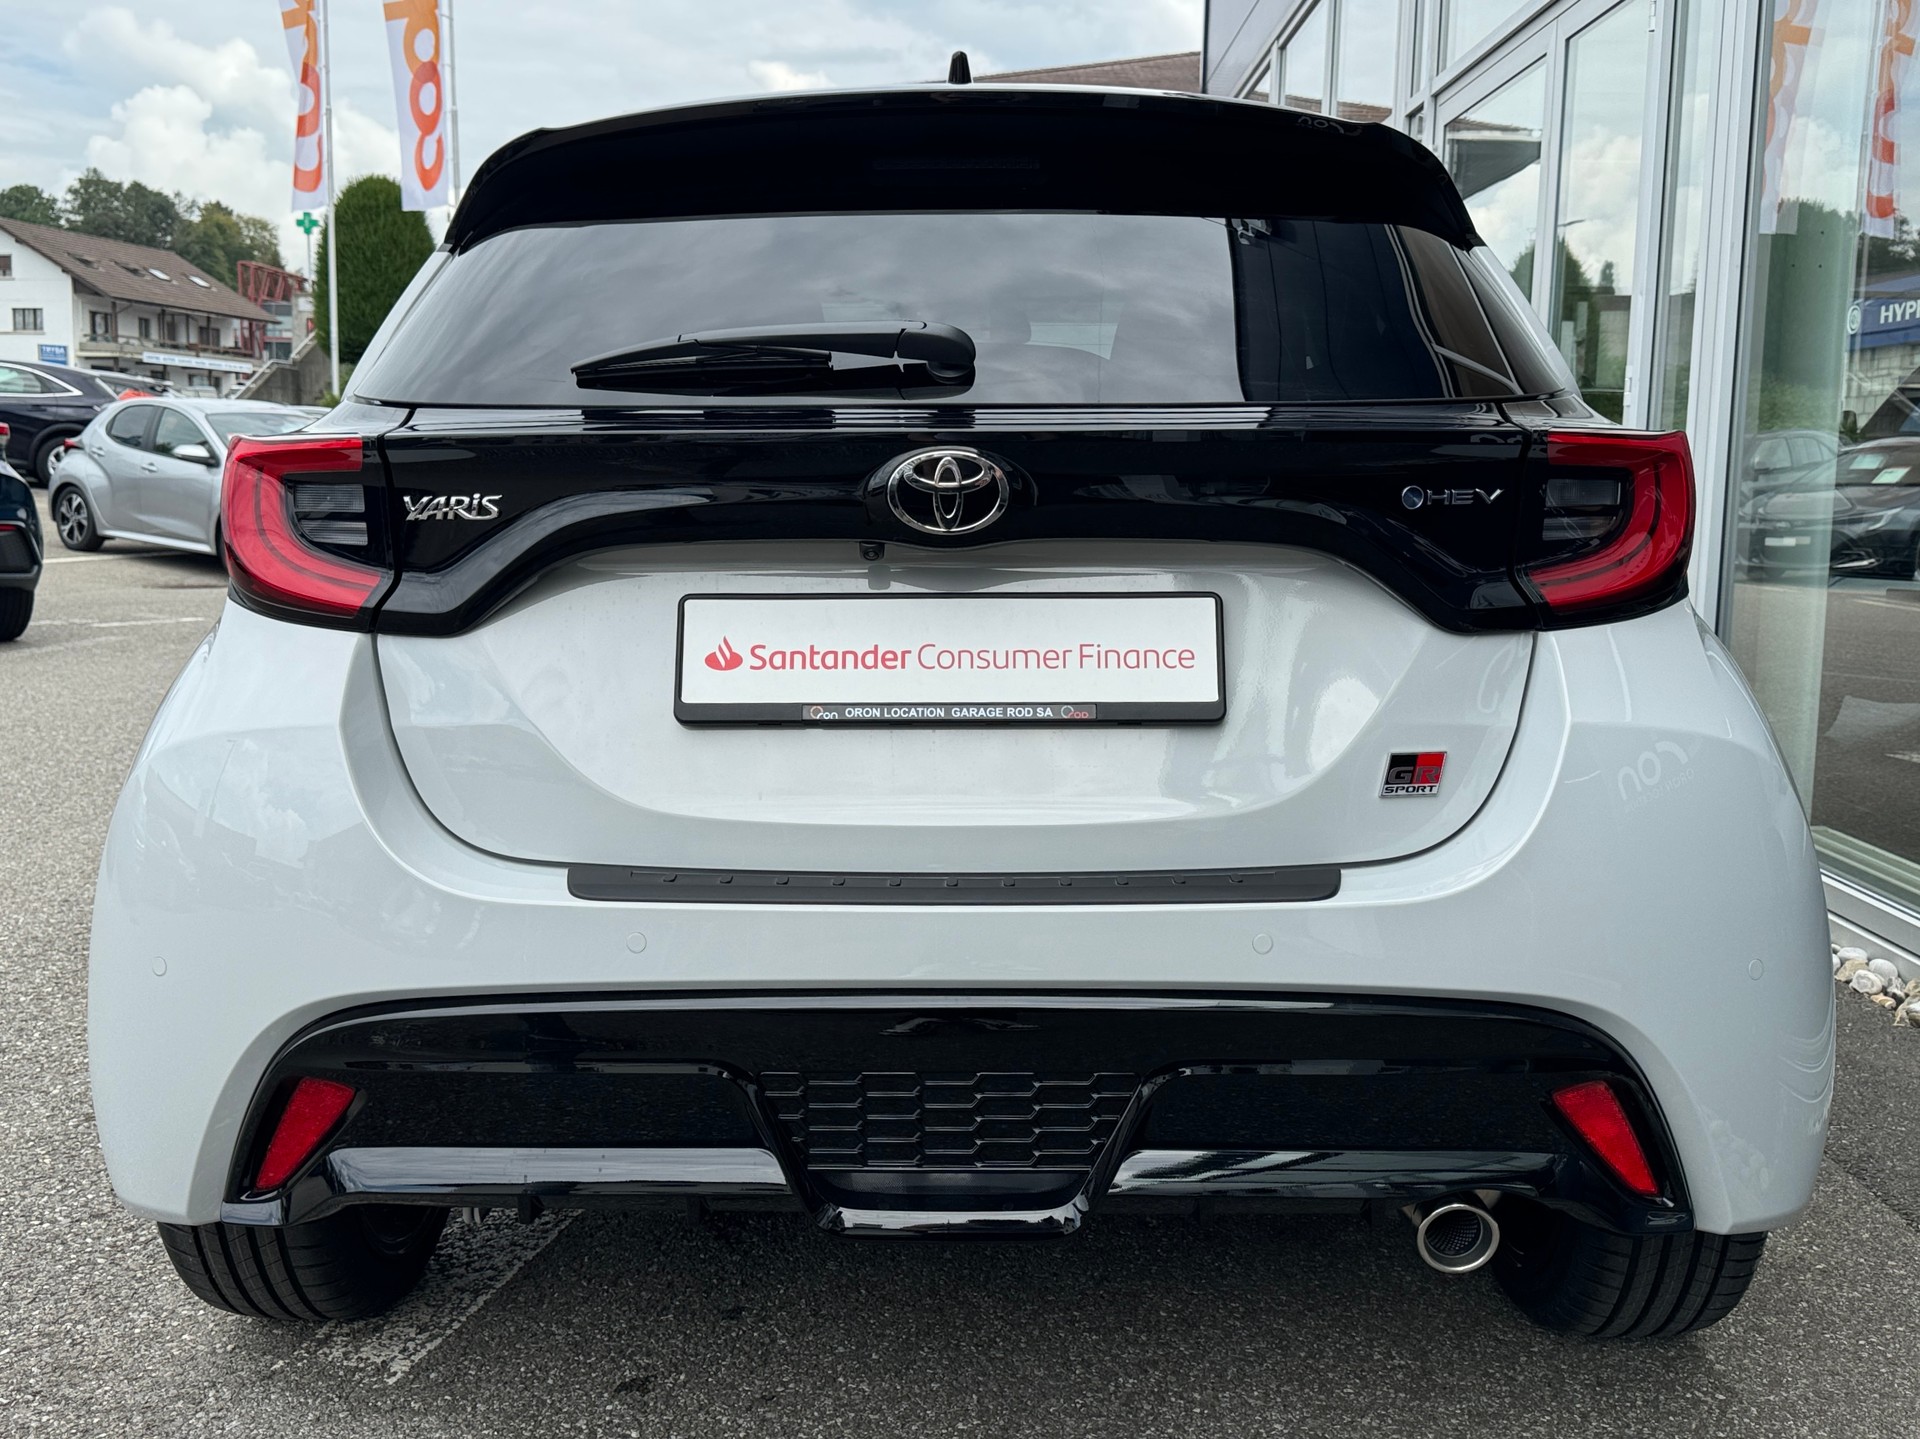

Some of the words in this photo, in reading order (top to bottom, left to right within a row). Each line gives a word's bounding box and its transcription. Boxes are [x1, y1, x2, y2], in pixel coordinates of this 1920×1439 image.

[1426, 488, 1504, 505] HEV
[750, 644, 912, 670] Santander
[917, 643, 1073, 670] Consumer
[1079, 643, 1196, 670] Finance
[845, 707, 881, 718] ORON
[884, 707, 945, 718] LOCATION
[951, 707, 1004, 718] GARAGE
[1007, 707, 1033, 718] ROD
[1036, 707, 1053, 718] SA
[1387, 766, 1441, 784] GR
[1384, 785, 1437, 794] SPORT
